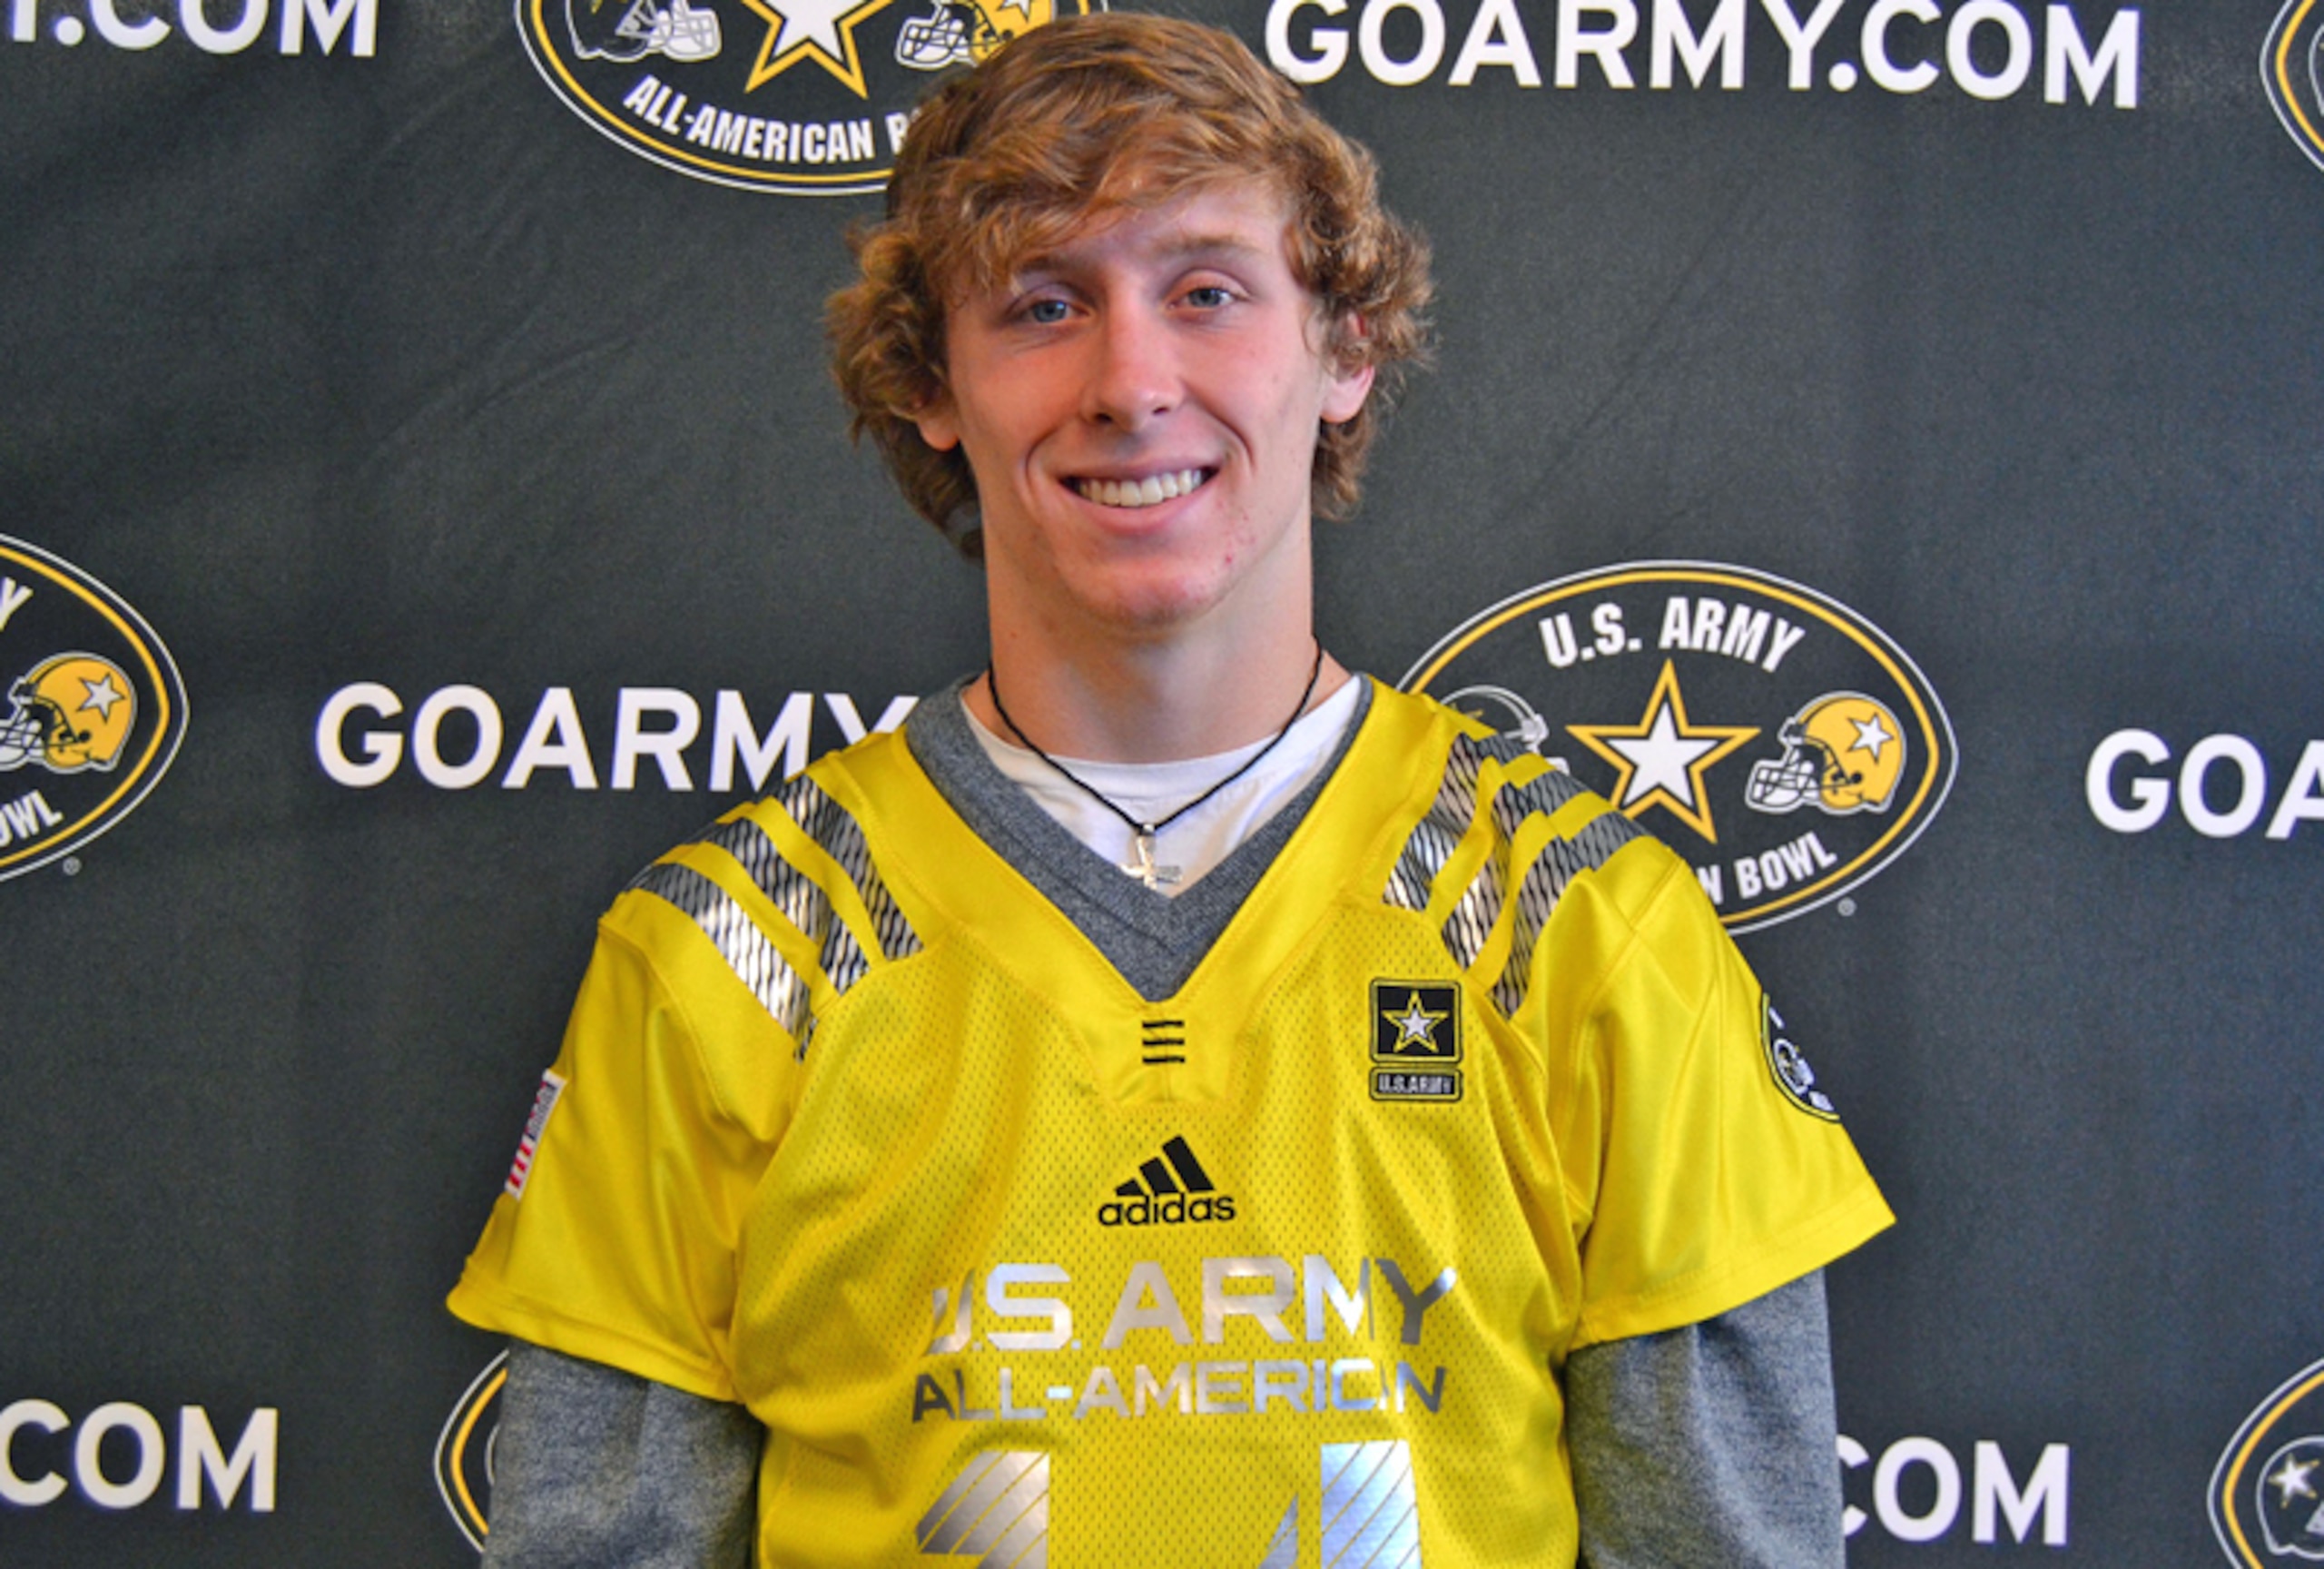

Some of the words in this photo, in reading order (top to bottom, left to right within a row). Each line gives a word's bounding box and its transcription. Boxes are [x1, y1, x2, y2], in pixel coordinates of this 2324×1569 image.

[1265, 0, 2140, 109] GOARMY.COM
[623, 74, 875, 164] ALL-AMERICAN
[1539, 602, 1643, 668] U.S.
[1658, 596, 1806, 673] ARMY
[1734, 831, 1837, 900] BOWL
[1098, 1192, 1236, 1227] adidas
[1100, 1254, 1457, 1349] ARMY
